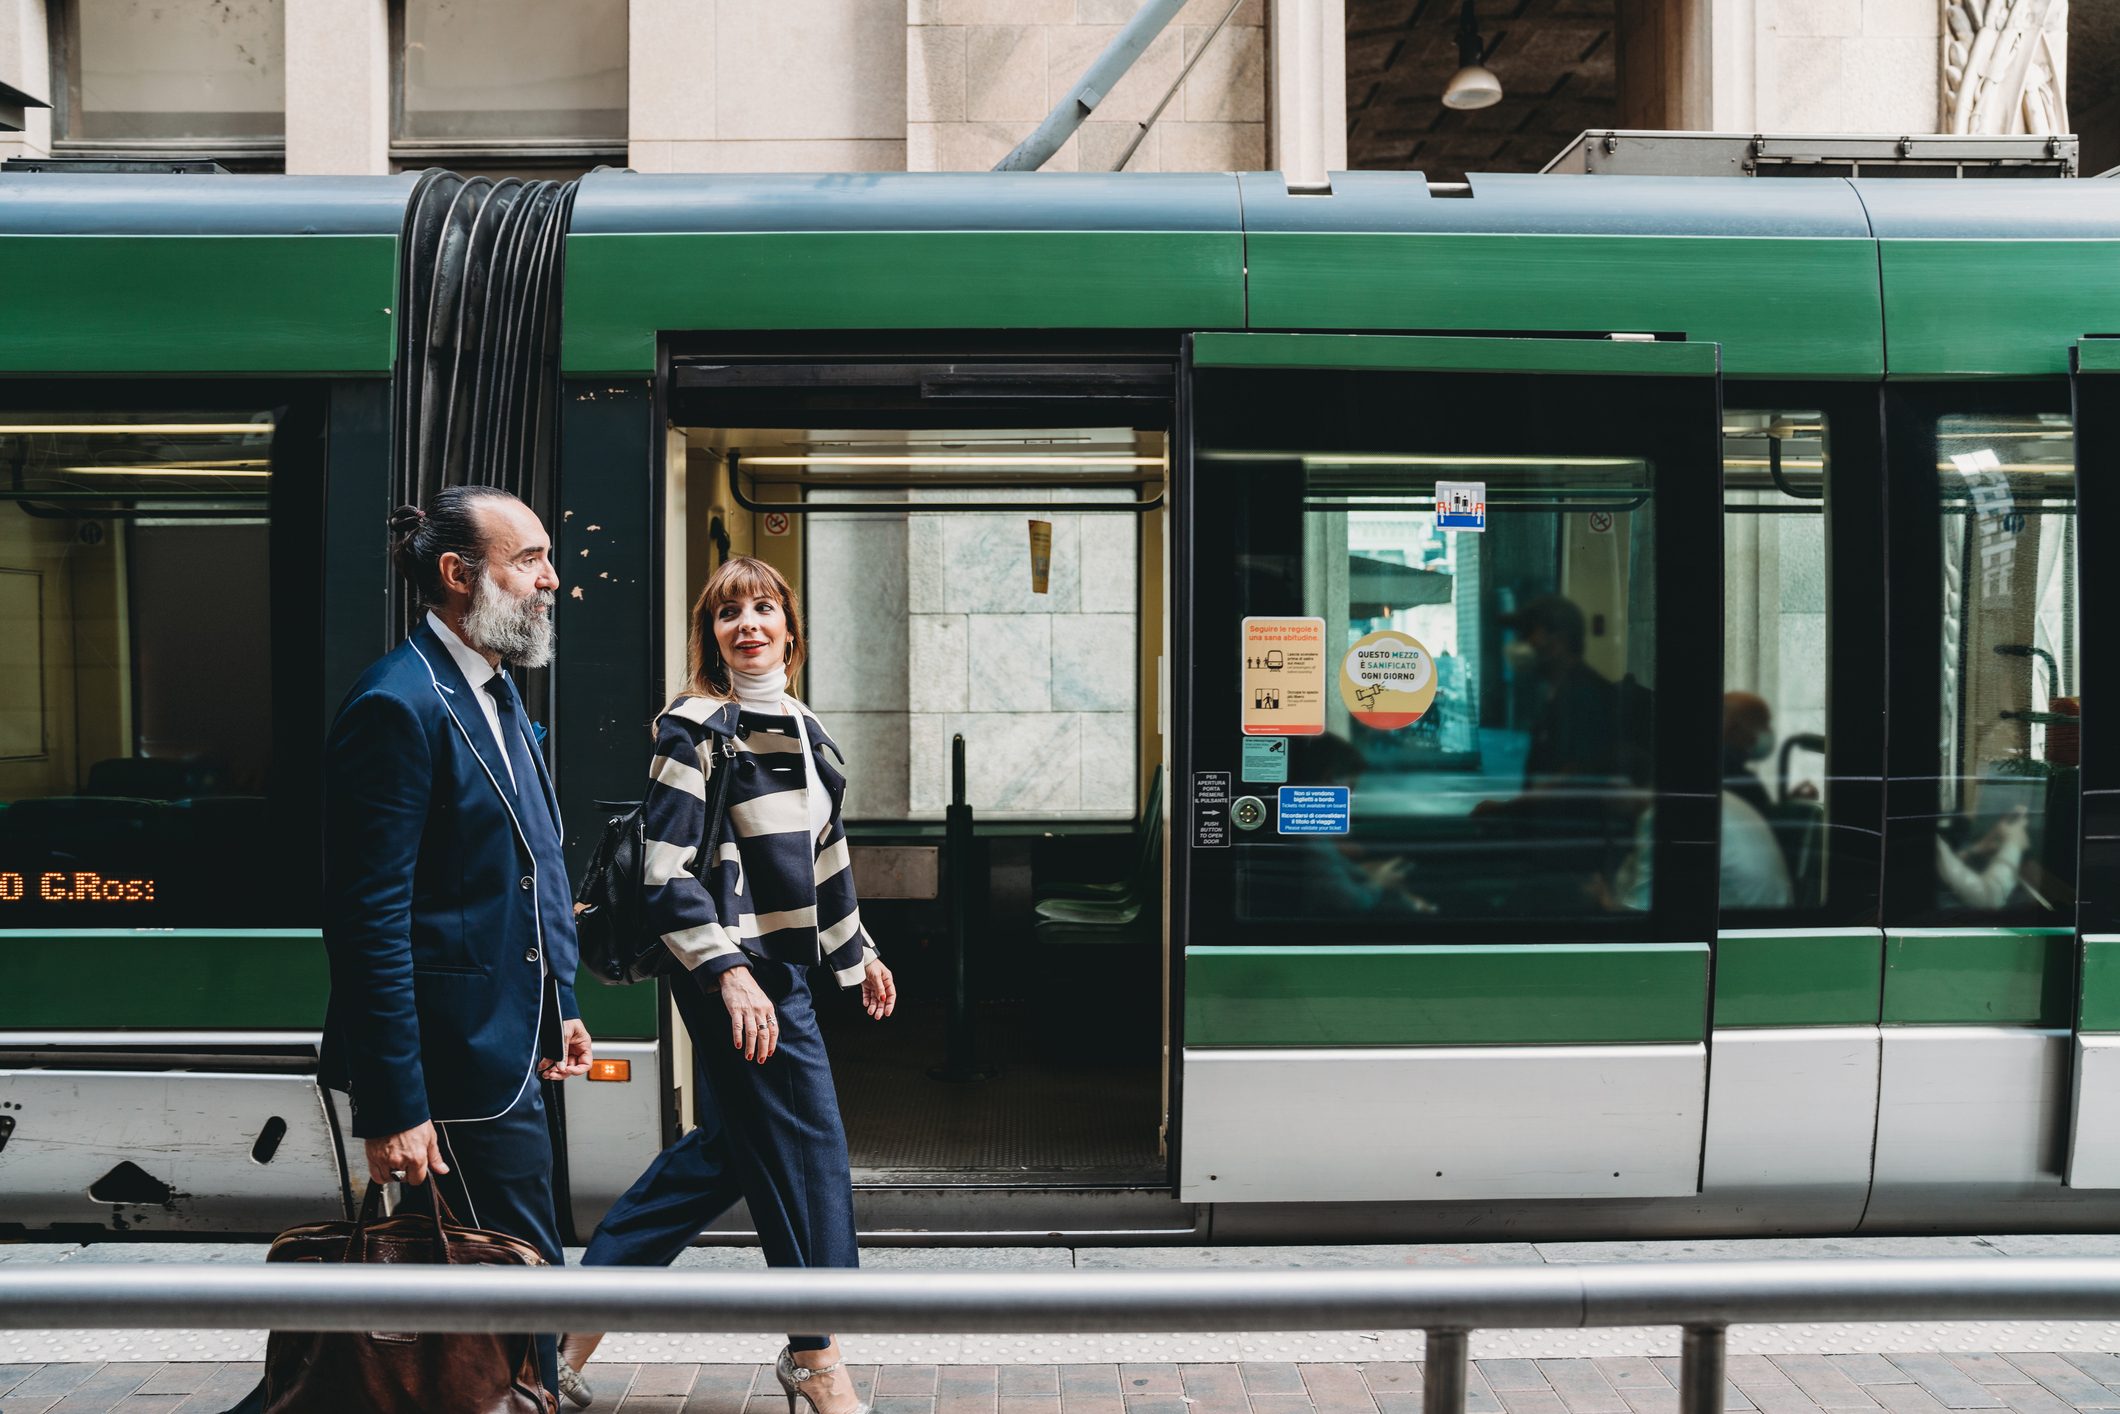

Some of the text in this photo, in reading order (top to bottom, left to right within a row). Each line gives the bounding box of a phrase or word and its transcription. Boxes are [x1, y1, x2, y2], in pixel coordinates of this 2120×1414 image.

[1249, 625, 1279, 633] Seguire
[1288, 625, 1312, 633] regole
[1392, 651, 1419, 659] MEZZO
[1360, 660, 1417, 669] È SANIFICATO
[1361, 672, 1415, 680] OGNI GIORNO
